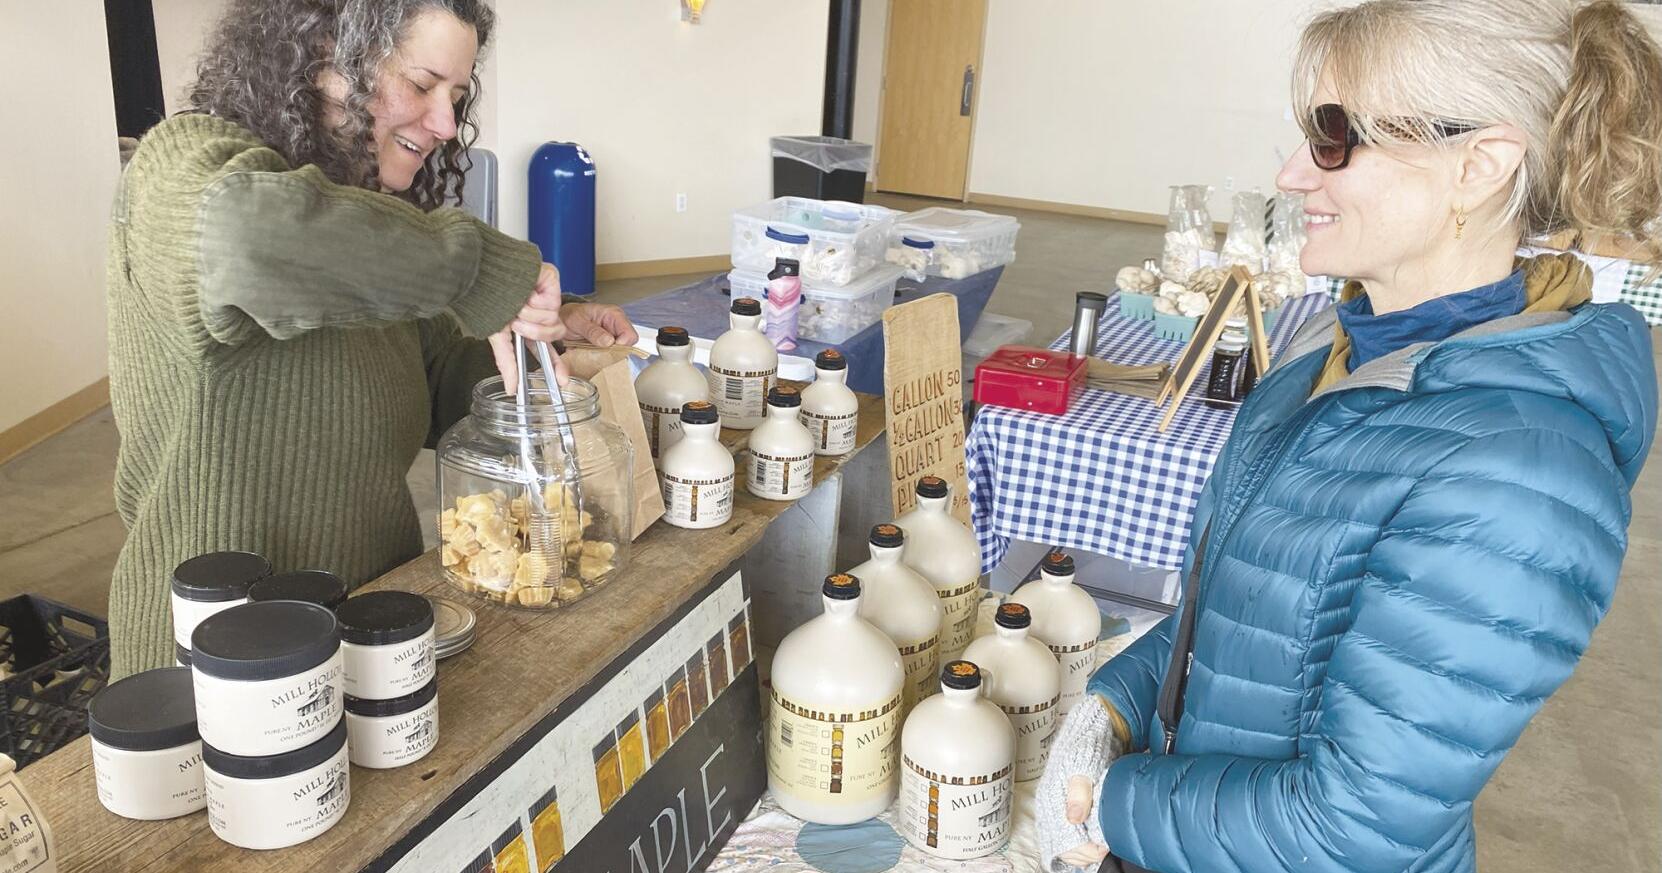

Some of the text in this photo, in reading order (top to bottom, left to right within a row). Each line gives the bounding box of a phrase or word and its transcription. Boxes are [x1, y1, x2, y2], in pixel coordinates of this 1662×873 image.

[892, 369, 960, 415] GALLON 50
[905, 399, 954, 443] GALLON
[895, 431, 963, 481] QUART 20
[703, 485, 722, 499] MILL
[943, 601, 961, 616] ILL
[393, 647, 416, 665] MILL
[904, 657, 926, 676] ILL
[1069, 652, 1095, 675] MILL
[271, 686, 306, 709] MILL
[297, 702, 338, 731] MAPLE
[1018, 716, 1049, 738] MILL
[386, 720, 411, 737] MILL
[857, 720, 889, 749] MILL
[171, 790, 187, 799] PURE
[293, 776, 325, 801] MILL
[607, 743, 732, 873] APLE
[951, 790, 989, 811] MILL
[13, 831, 34, 848] Sugar
